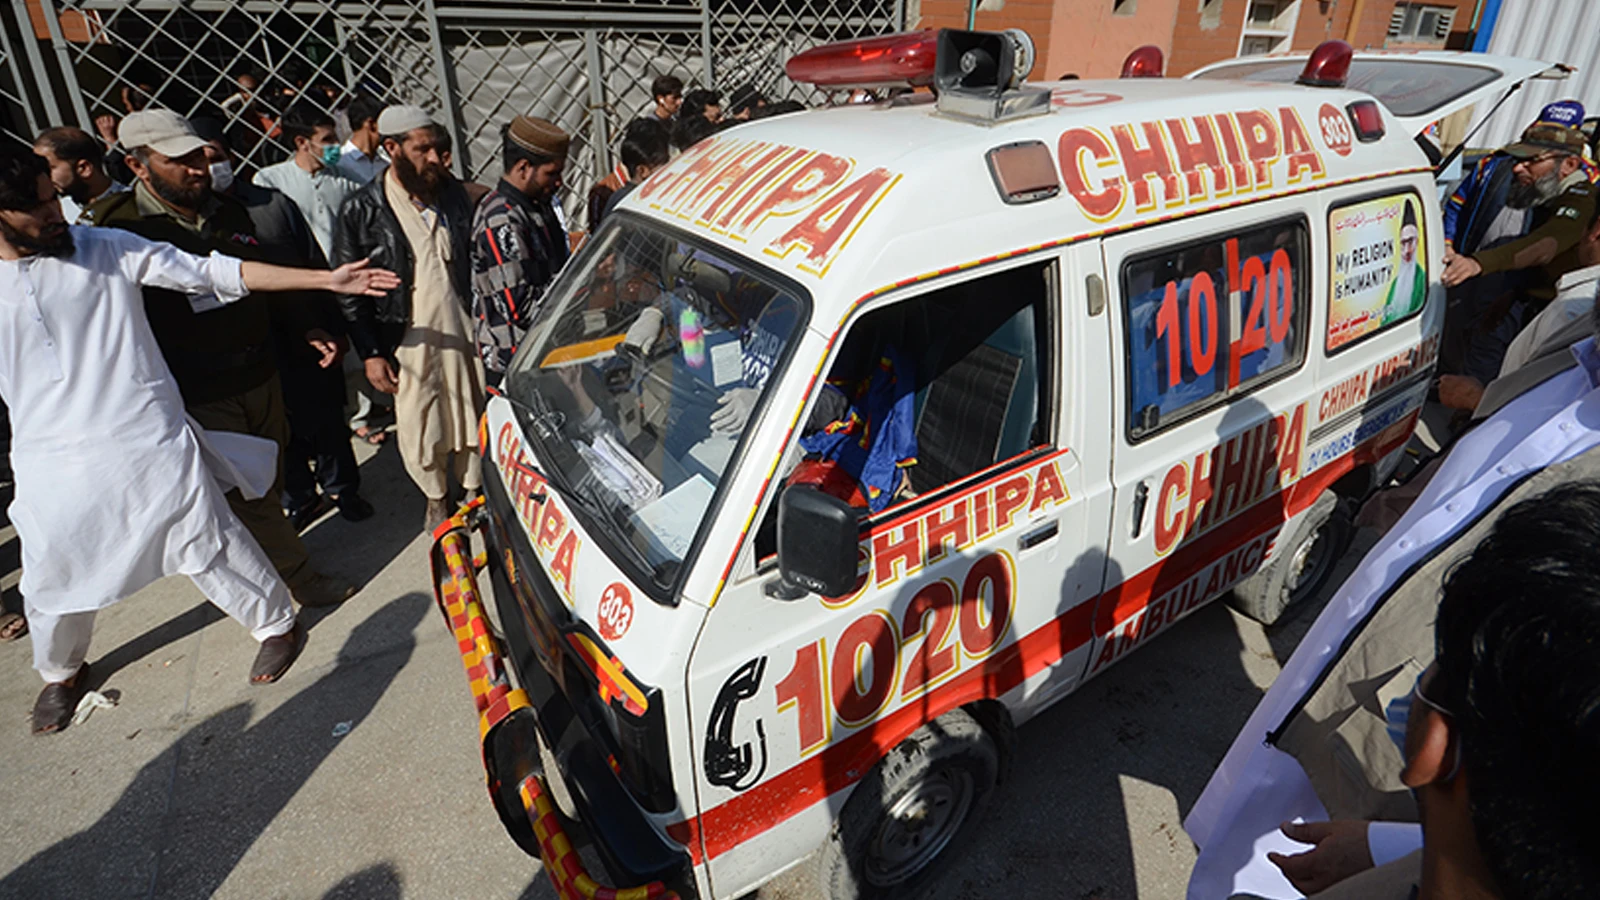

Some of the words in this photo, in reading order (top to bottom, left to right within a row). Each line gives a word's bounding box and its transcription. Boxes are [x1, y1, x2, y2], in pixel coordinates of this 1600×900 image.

[1057, 105, 1328, 224] CHHIPA
[1319, 114, 1351, 150] 303
[640, 135, 903, 279] CHHIPA
[1336, 252, 1350, 275] My
[1351, 238, 1395, 269] RELIGION
[1155, 270, 1219, 388] 10
[1240, 248, 1293, 358] 20
[1343, 264, 1394, 297] HUMANITY
[1318, 369, 1369, 423] CHHIPA
[497, 420, 583, 607] CHHIPA
[1154, 401, 1309, 557] CHHIPA
[599, 586, 632, 633] 303
[774, 548, 1018, 758] 1020
[1092, 526, 1278, 672] AMBULANCE
